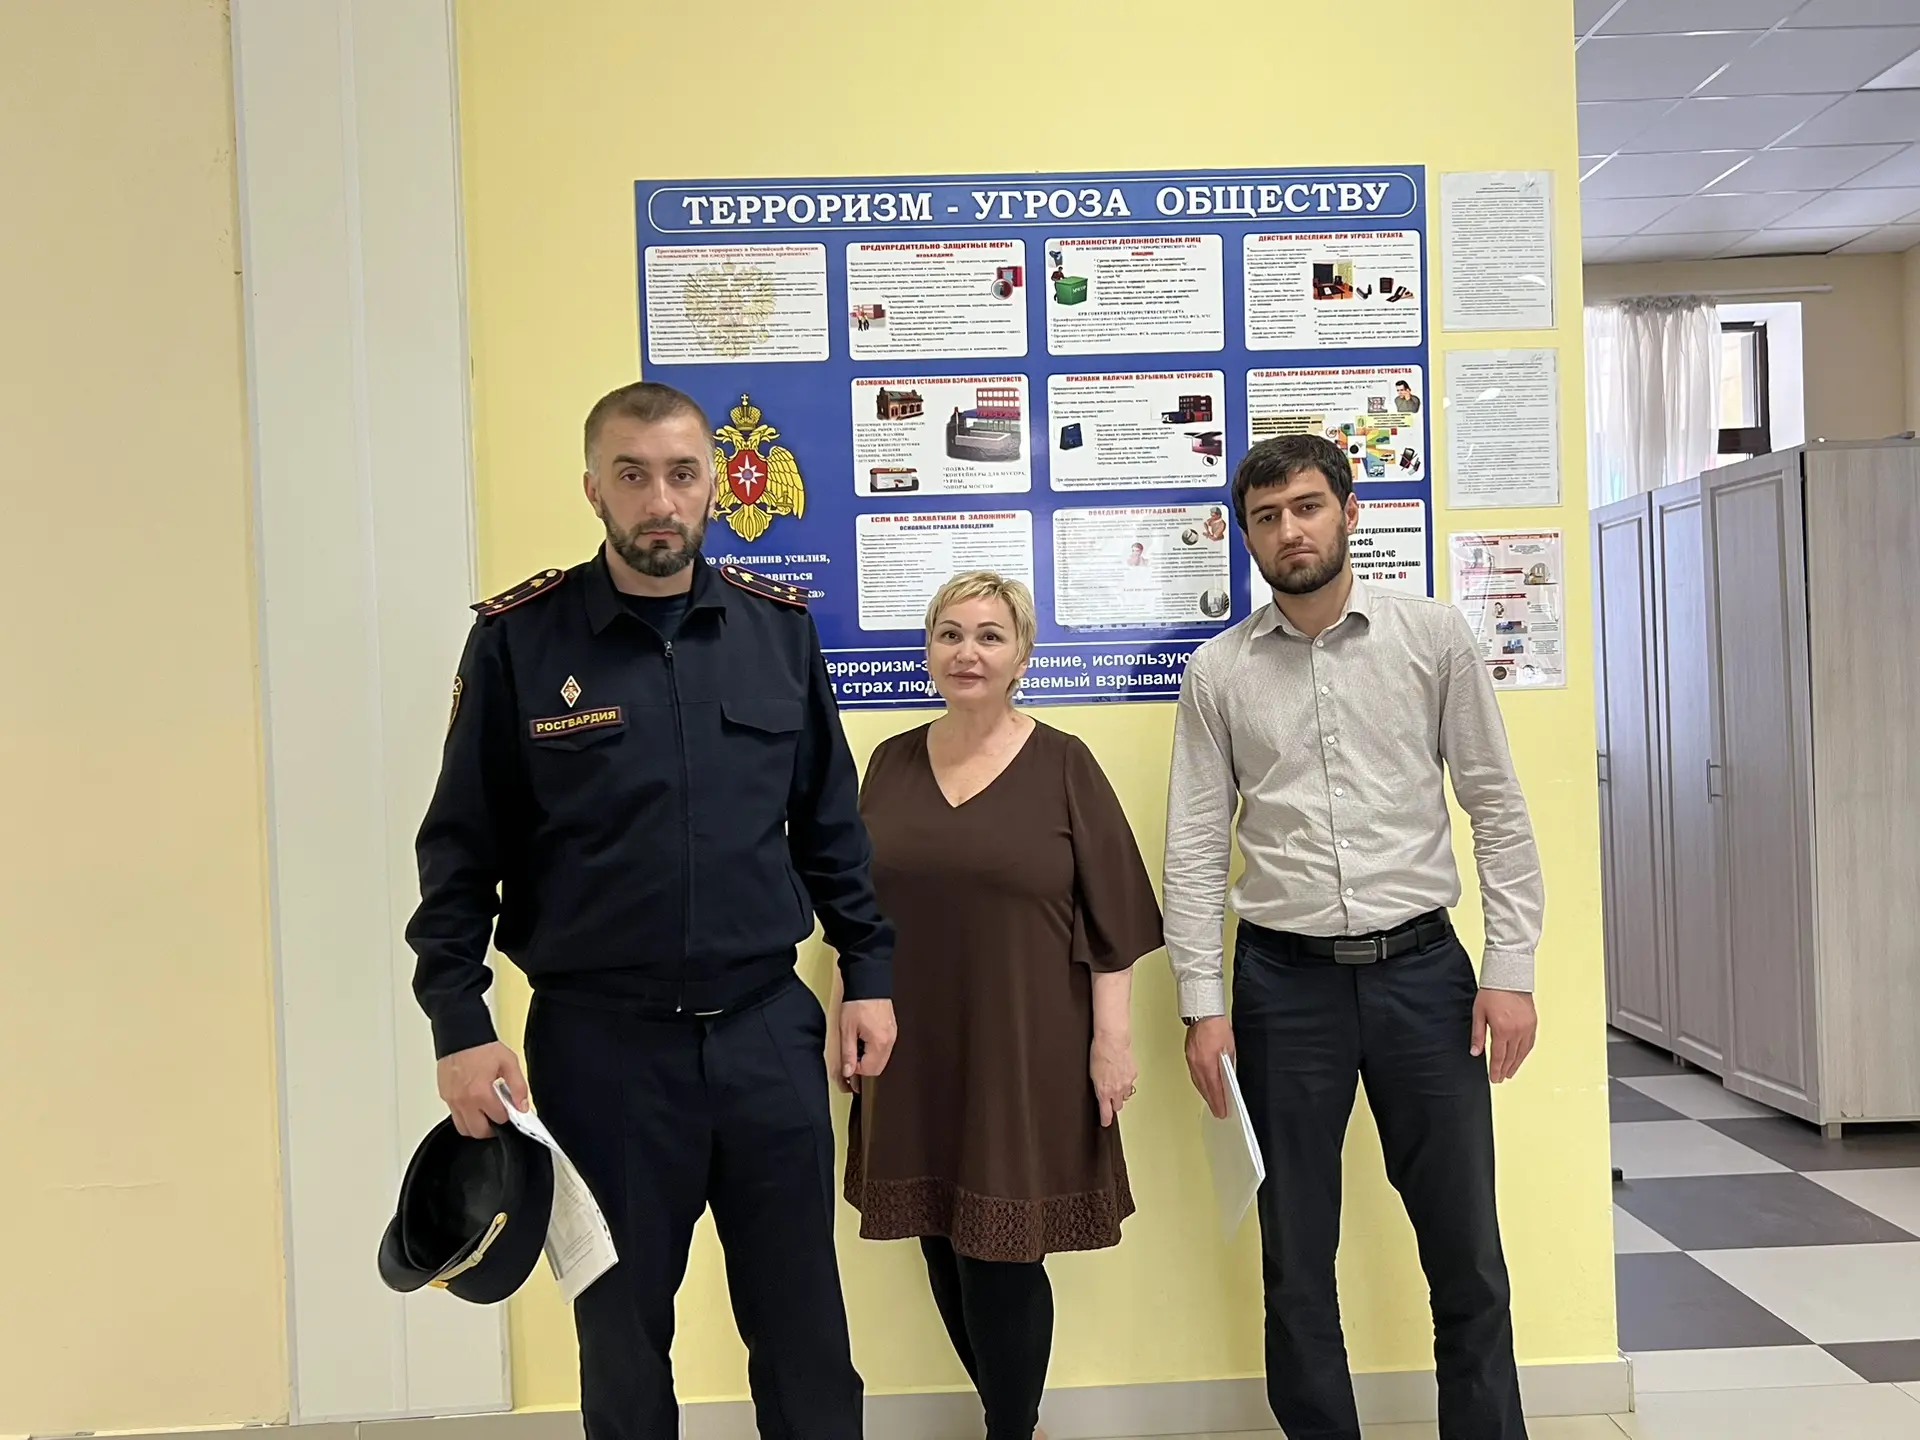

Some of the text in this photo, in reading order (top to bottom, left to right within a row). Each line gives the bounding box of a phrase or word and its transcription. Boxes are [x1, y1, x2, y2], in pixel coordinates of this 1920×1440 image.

[682, 192, 934, 226] ТЕРРОРИЗМ
[971, 187, 1131, 220] УГРОЗА
[1156, 182, 1390, 218] ОБЩЕСТВУ
[719, 554, 782, 565] объединив
[784, 554, 830, 566] усилия,
[826, 652, 1190, 677] ерроризм-э ление, использую
[842, 682, 893, 696] страх
[898, 680, 937, 694] люд
[1020, 673, 1090, 689] ваемый
[536, 710, 616, 732] РОСГВАРДИЯ
